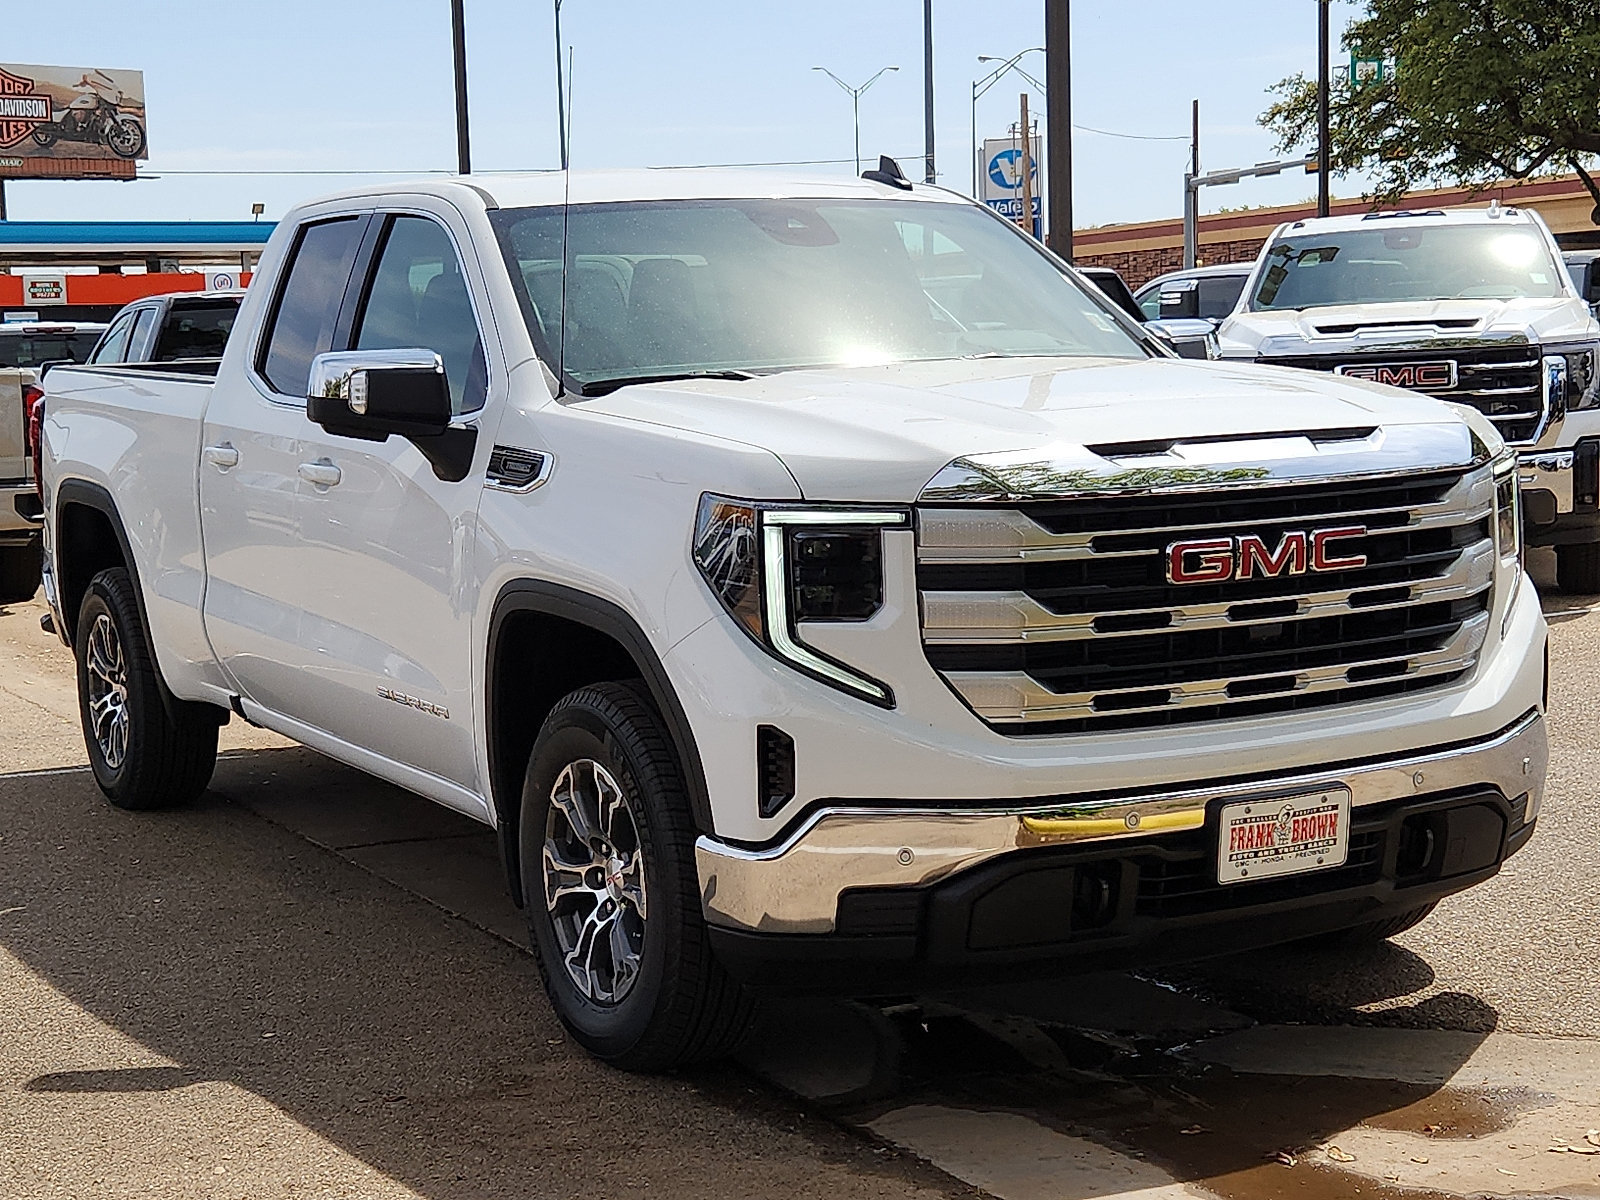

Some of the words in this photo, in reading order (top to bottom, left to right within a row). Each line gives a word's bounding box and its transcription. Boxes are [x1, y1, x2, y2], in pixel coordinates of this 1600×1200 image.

[0, 98, 46, 117] DAVIDSON
[0, 121, 26, 142] LES
[988, 201, 1038, 213] Valeo
[1344, 365, 1448, 385] GMC
[1166, 525, 1367, 584] GMC
[376, 685, 450, 720] SIERRA
[1230, 823, 1277, 852] FRANK
[1291, 813, 1339, 843] BROWN
[1231, 852, 1255, 861] AUTO
[1278, 845, 1305, 853] TRUCK
[1235, 860, 1250, 868] GMC
[1261, 856, 1284, 864] HONDA
[1295, 848, 1330, 858] PREOWNED
